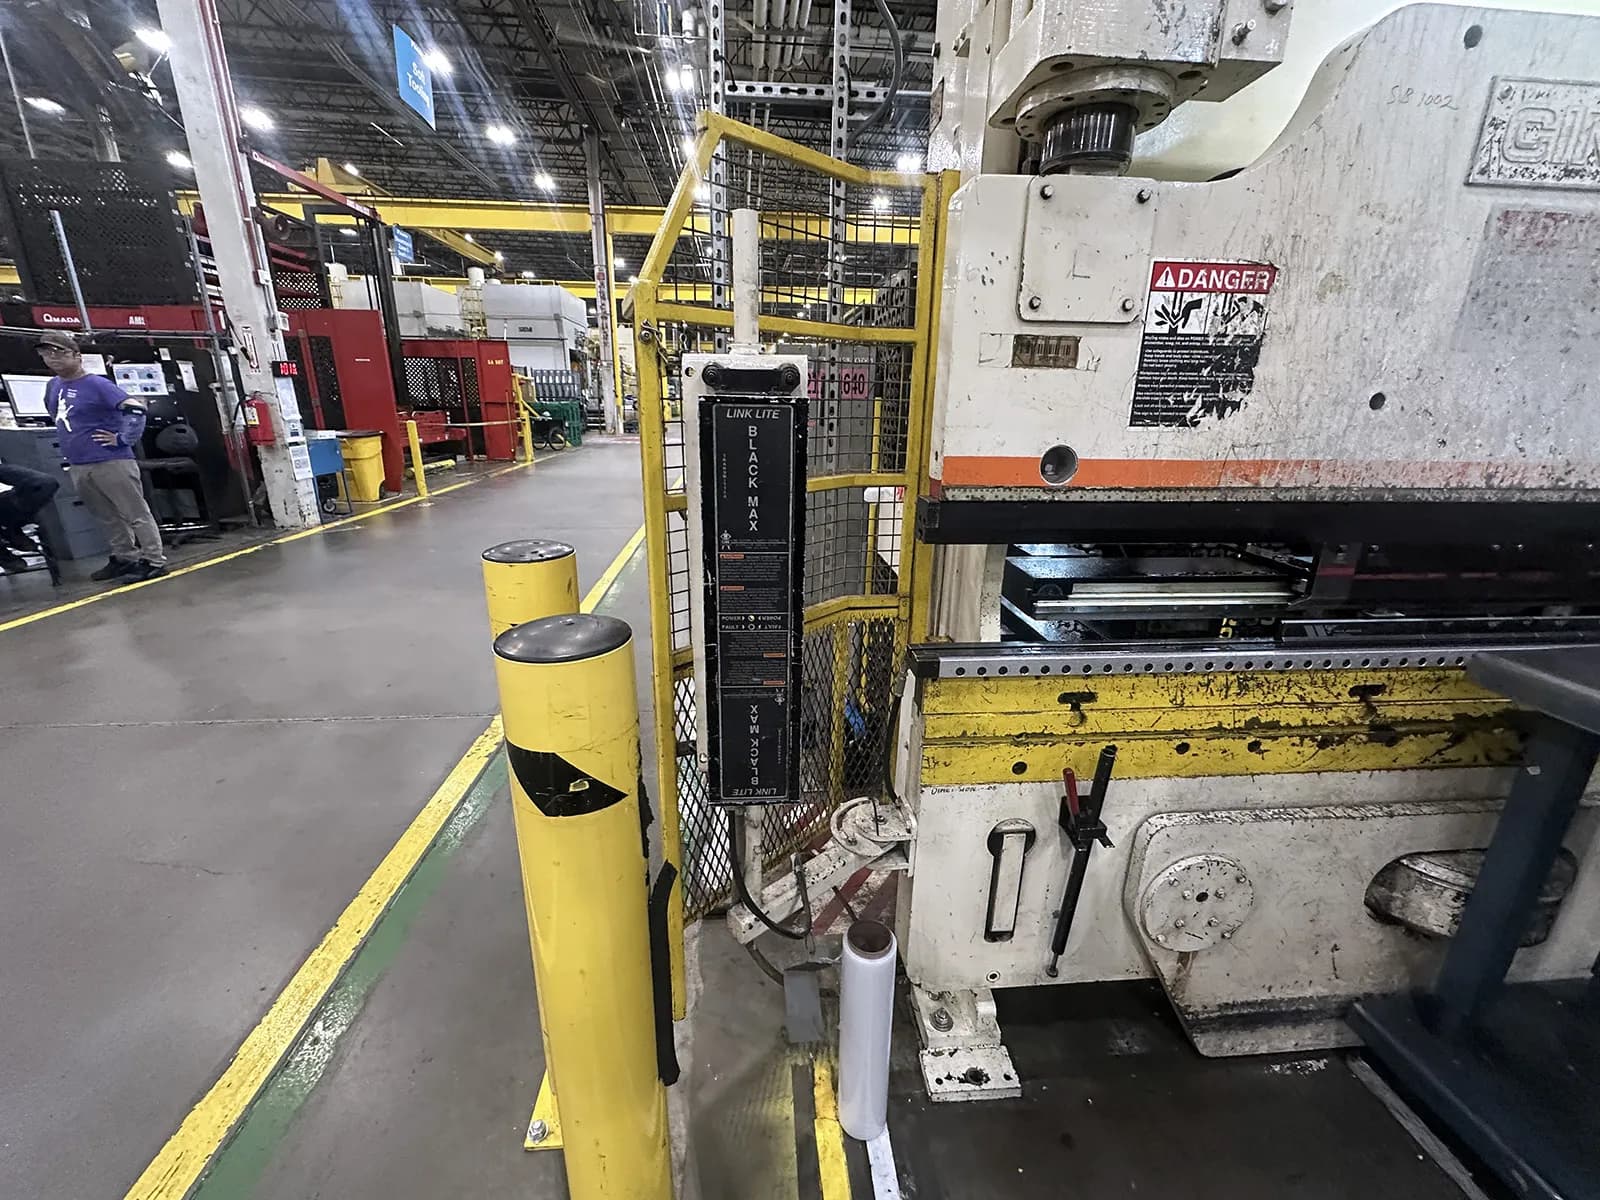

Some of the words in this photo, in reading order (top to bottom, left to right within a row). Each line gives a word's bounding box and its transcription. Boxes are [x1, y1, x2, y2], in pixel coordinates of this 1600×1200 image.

[1416, 93, 1459, 111] 1002
[1177, 267, 1270, 291] DANGER
[726, 408, 753, 419] LINK
[755, 409, 781, 419] LITE
[748, 425, 759, 489] BLACK
[747, 496, 759, 532] MAX
[749, 704, 760, 735] MAX
[750, 738, 760, 786] BLACK
[731, 787, 753, 796] LITE
[756, 787, 778, 796] LINK
